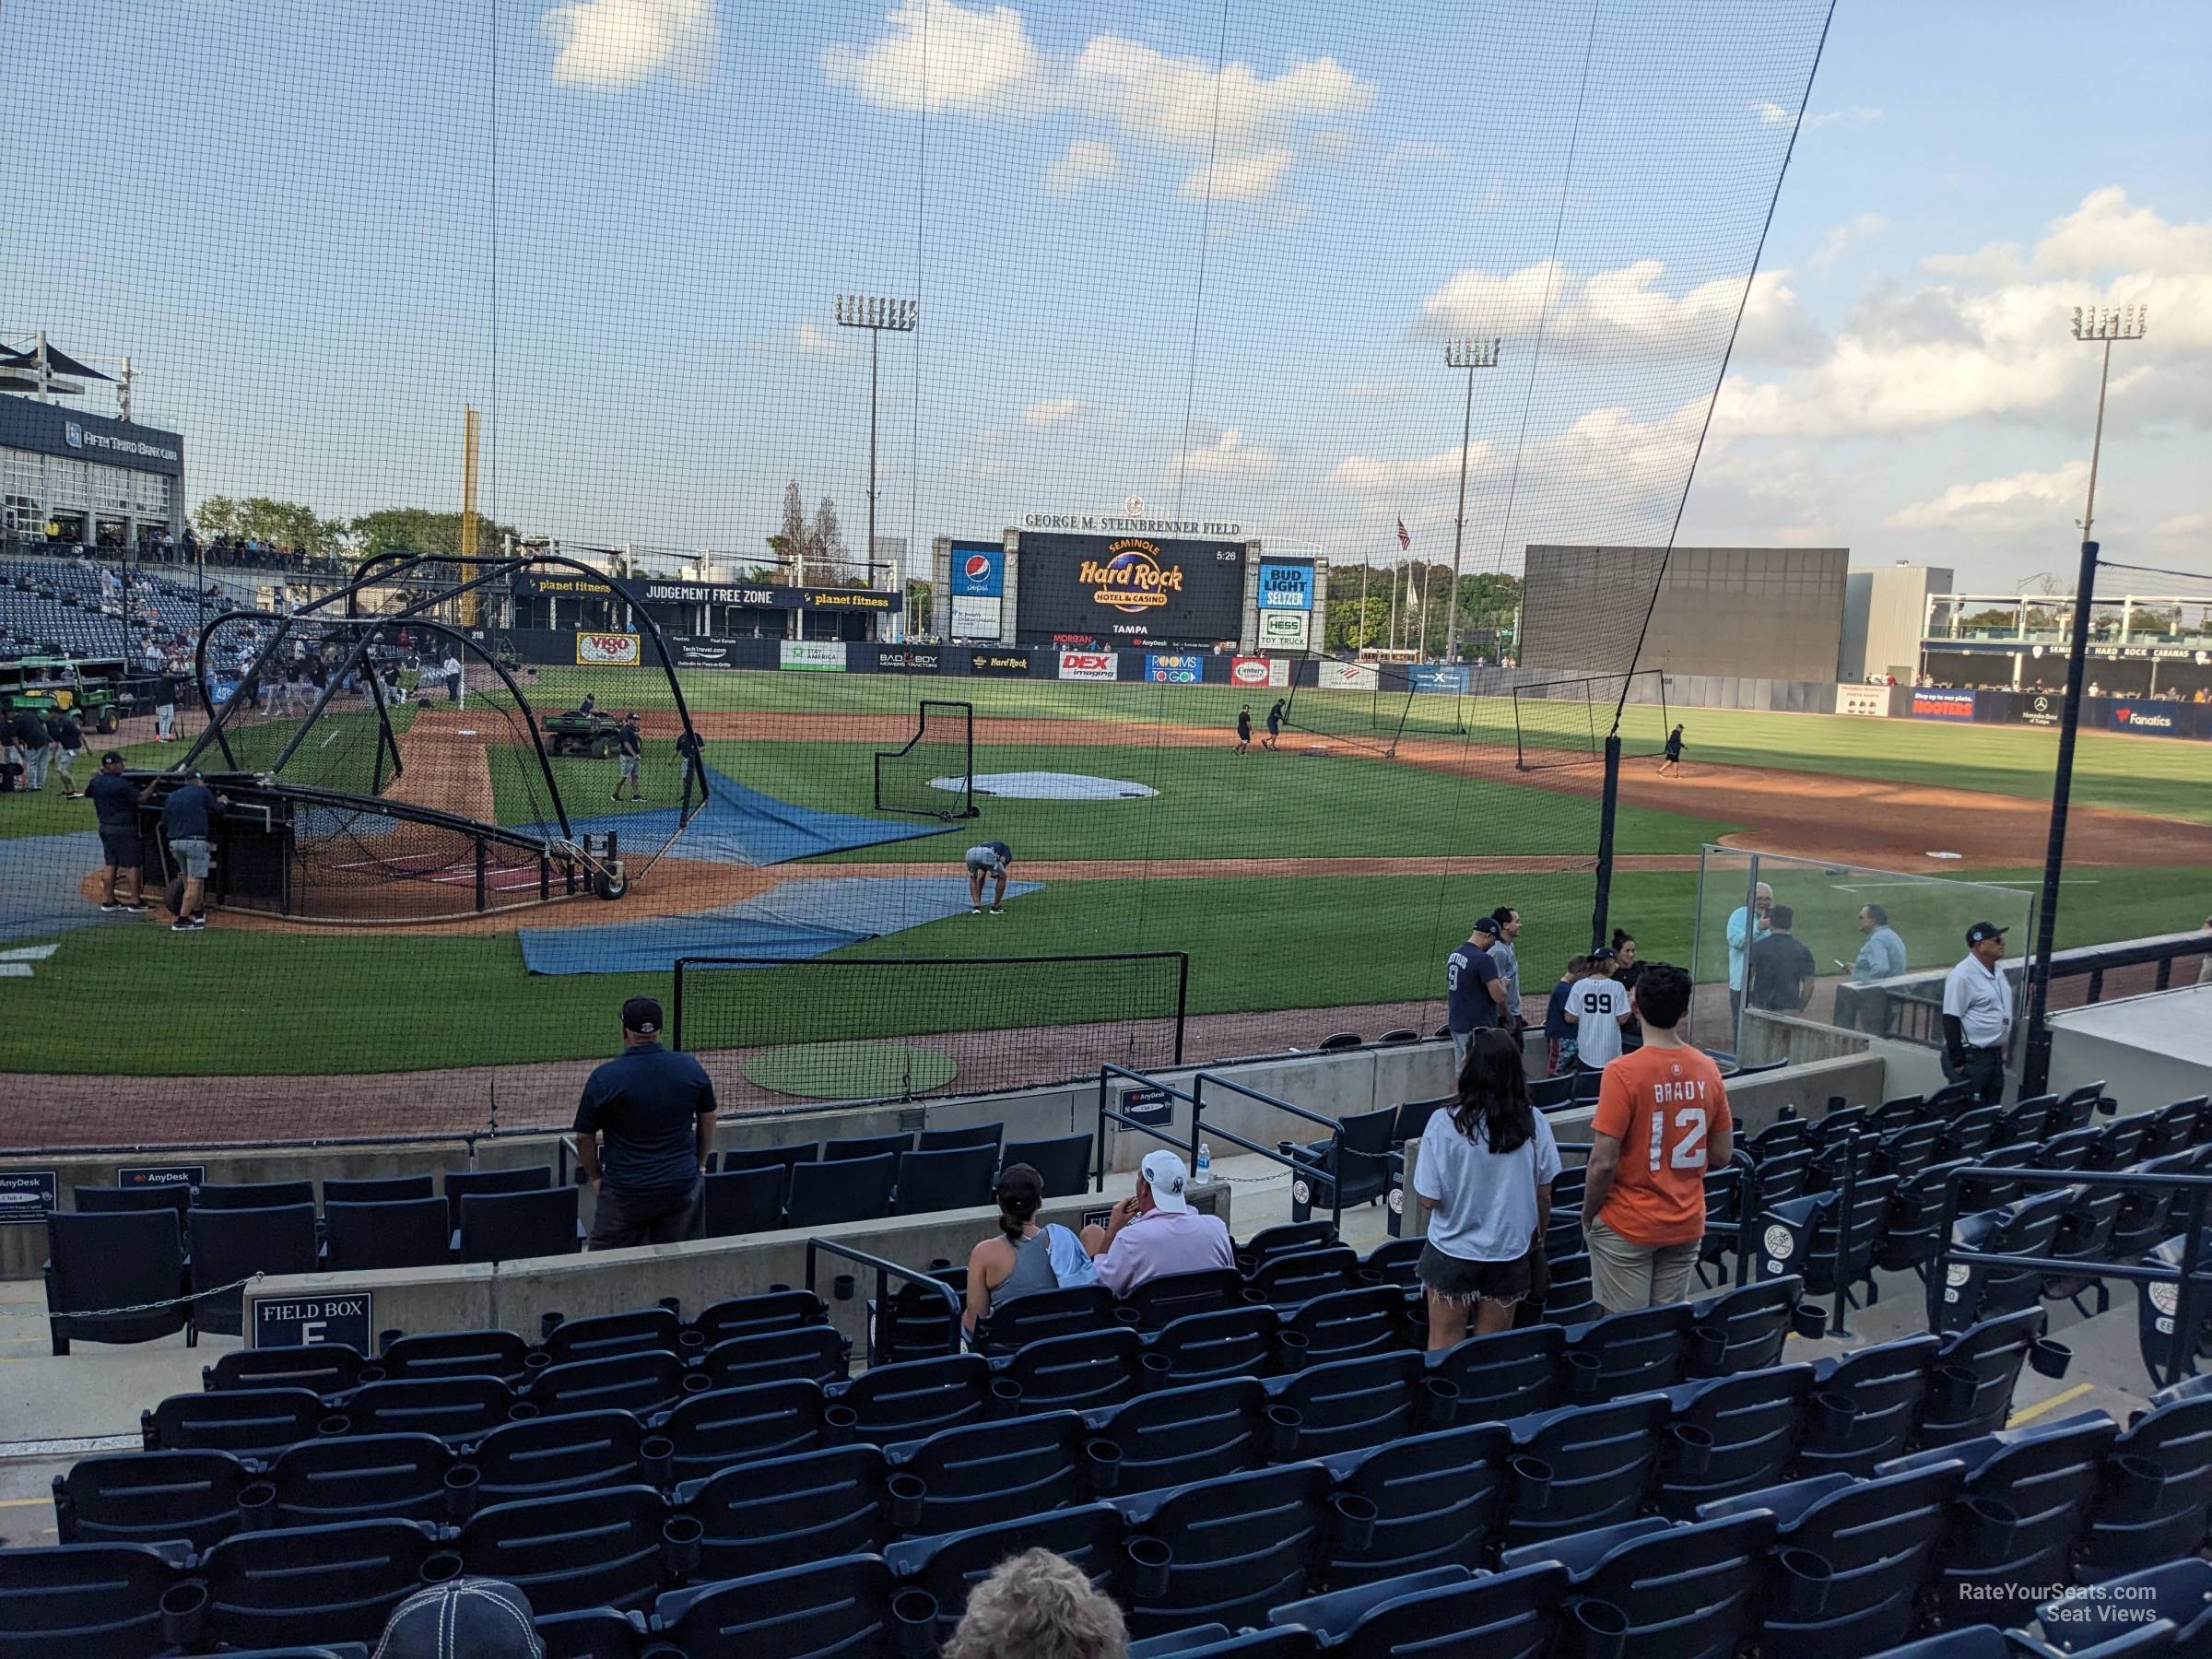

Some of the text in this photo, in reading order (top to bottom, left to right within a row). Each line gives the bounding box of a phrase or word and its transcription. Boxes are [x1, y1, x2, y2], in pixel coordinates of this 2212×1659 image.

[111, 437, 136, 453] THIRD
[1025, 513, 1240, 535] GEORGE M. STEINBRENNER FIELD
[1109, 538, 1161, 555] SEMINOLE
[1217, 551, 1236, 561] 5:26
[1079, 560, 1183, 591] Hard Rock
[1271, 570, 1301, 581] BUD
[539, 581, 573, 593] planet
[1265, 581, 1307, 592] LIGHT
[646, 585, 772, 604] JUDGEMENT FREE ZONE
[815, 593, 889, 607] planet fitness
[1133, 594, 1164, 603] CASINO
[1267, 592, 1302, 606] SELTZER
[1113, 625, 1147, 634] TAMPA
[1270, 621, 1299, 629] HESS
[1279, 637, 1305, 646] TRUCK
[880, 653, 903, 662] BAD
[2095, 647, 2118, 655] HARD
[2124, 648, 2147, 656] ROCK
[2153, 649, 2190, 657] CABANAS
[990, 657, 1009, 666] Hard
[1009, 657, 1027, 669] Rock
[1062, 655, 1111, 669] DEX
[1152, 655, 1196, 667] ROOMS
[1074, 669, 1114, 677] imaging
[1152, 670, 1190, 681] TO GO
[1237, 666, 1265, 677] Century
[1912, 700, 1973, 716] HOOTERS
[2130, 713, 2171, 726] Fanatics
[1584, 993, 1611, 1014] 99
[1140, 1091, 1165, 1100] AnyDesk
[1654, 1080, 1705, 1103] BRADY
[1650, 1108, 1707, 1171] 12
[0, 1178, 41, 1189] AnyDesk
[148, 1172, 189, 1183] AnyDesk
[263, 1300, 362, 1321] FIELD BOX
